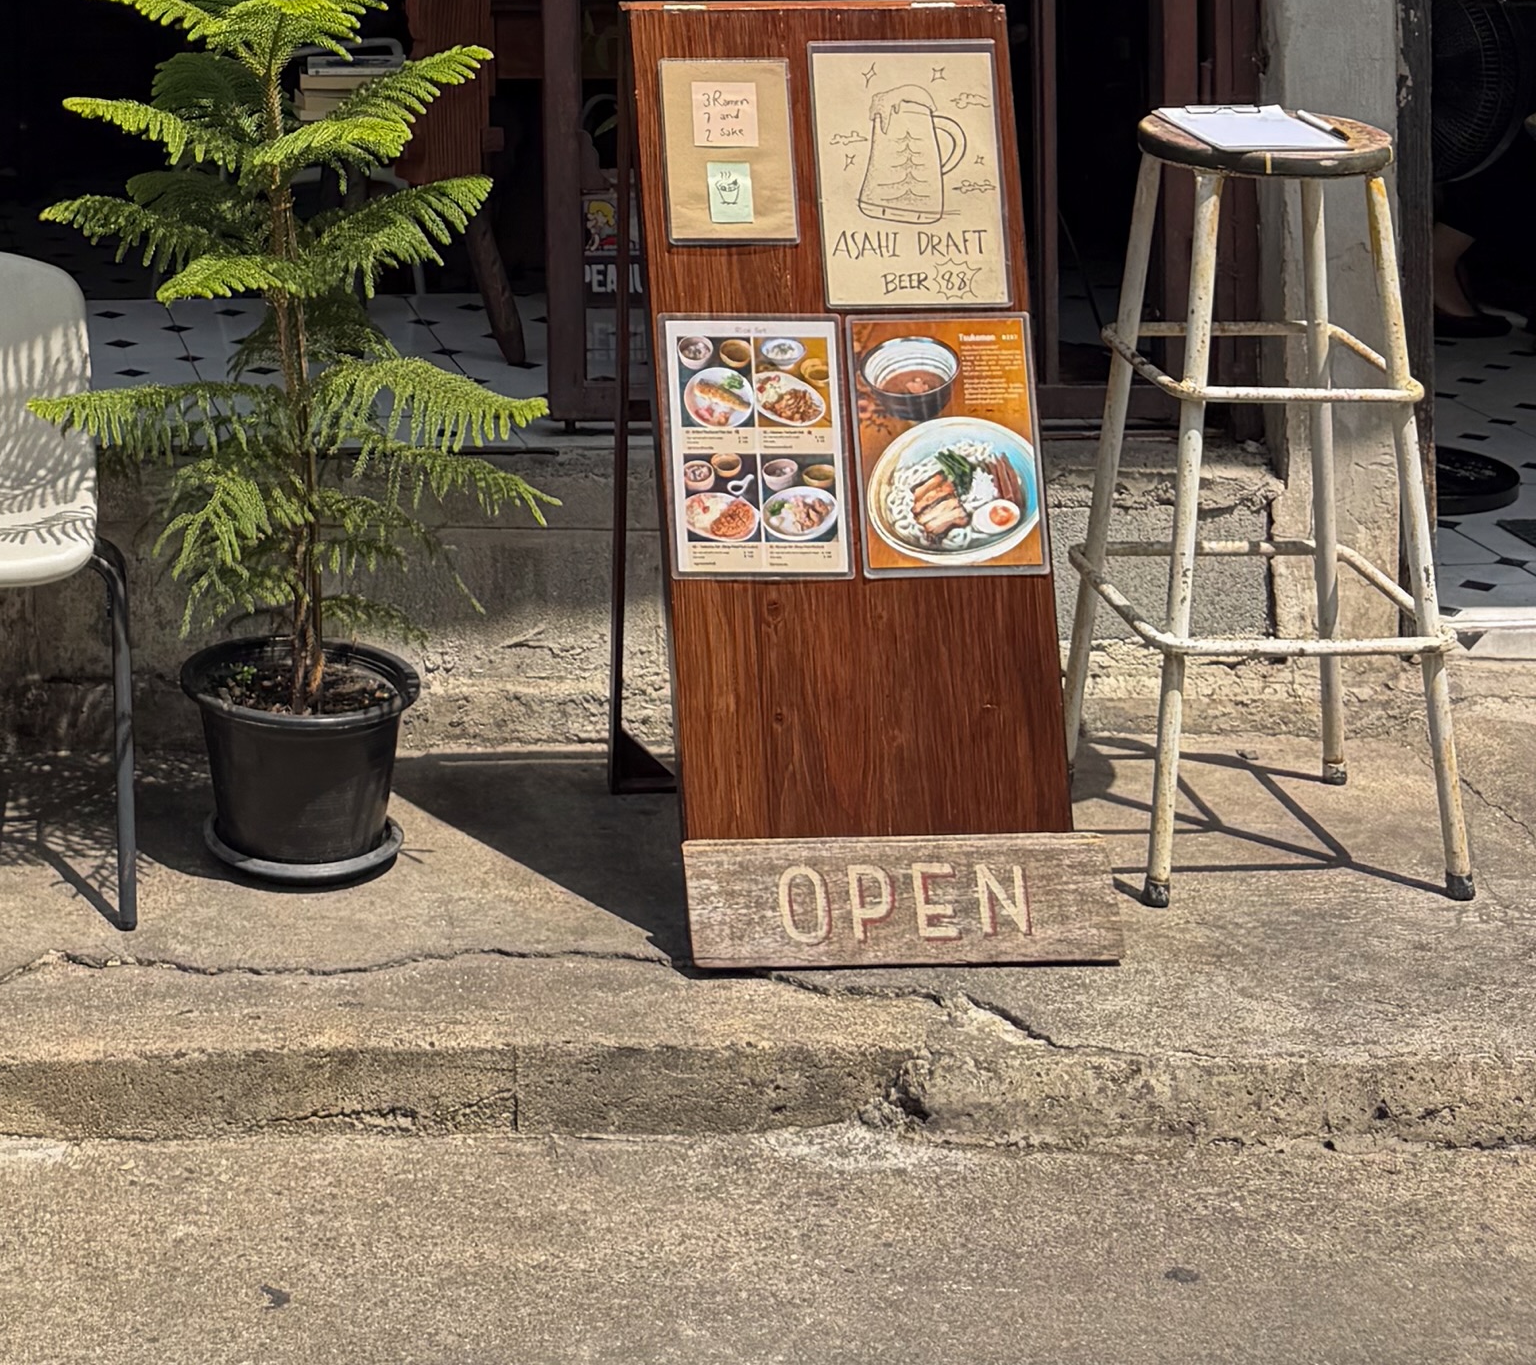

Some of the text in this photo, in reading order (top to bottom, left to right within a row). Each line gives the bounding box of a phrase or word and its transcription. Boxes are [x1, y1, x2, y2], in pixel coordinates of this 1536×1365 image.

[702, 90, 750, 107] 3 Ramen
[704, 109, 740, 123] 7 and
[705, 129, 713, 143] 2
[832, 229, 987, 260] ASAHI DRAFT
[881, 271, 930, 295] BEER
[777, 861, 1033, 946] OPEN
